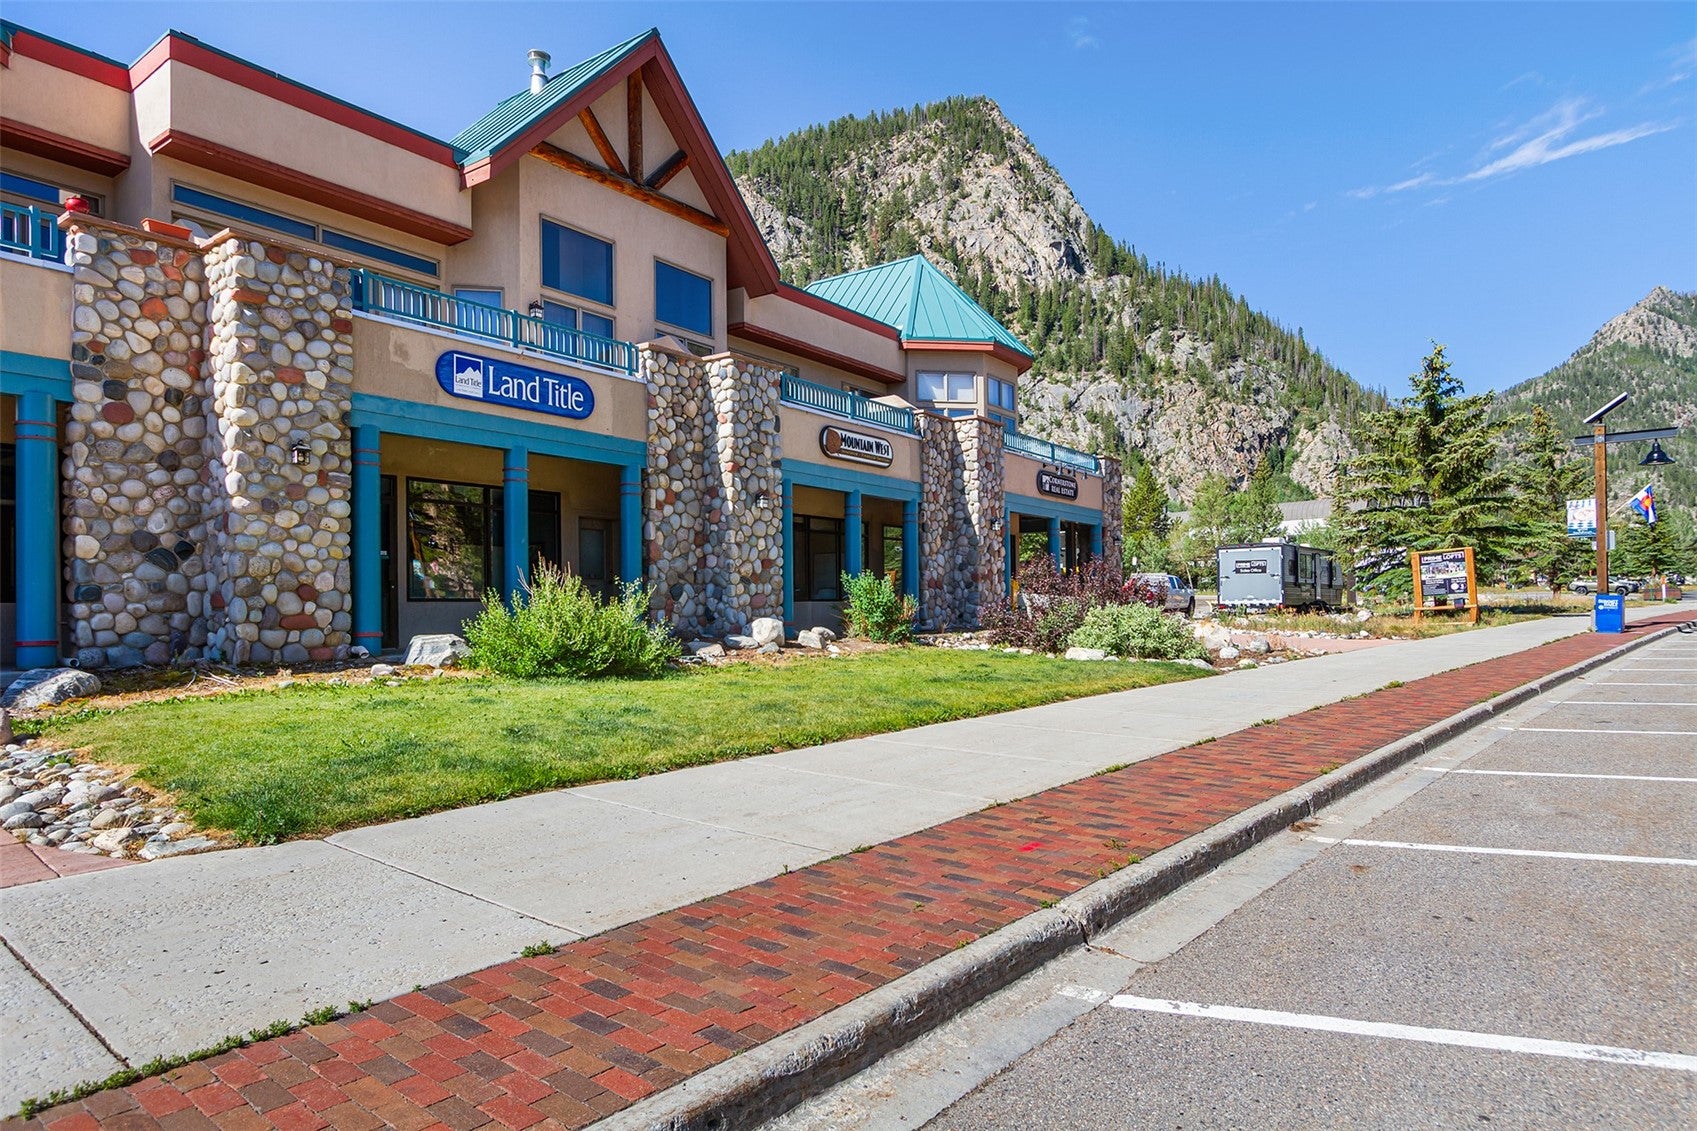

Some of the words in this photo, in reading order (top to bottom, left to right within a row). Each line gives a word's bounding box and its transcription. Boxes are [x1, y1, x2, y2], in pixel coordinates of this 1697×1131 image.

[455, 375, 469, 385] Land
[470, 378, 482, 388] Title
[488, 365, 540, 404] Land
[543, 377, 584, 412] Title
[840, 432, 874, 454] MOUNTAIN
[874, 440, 890, 457] WEST
[1050, 475, 1077, 489] CORNERSTONE
